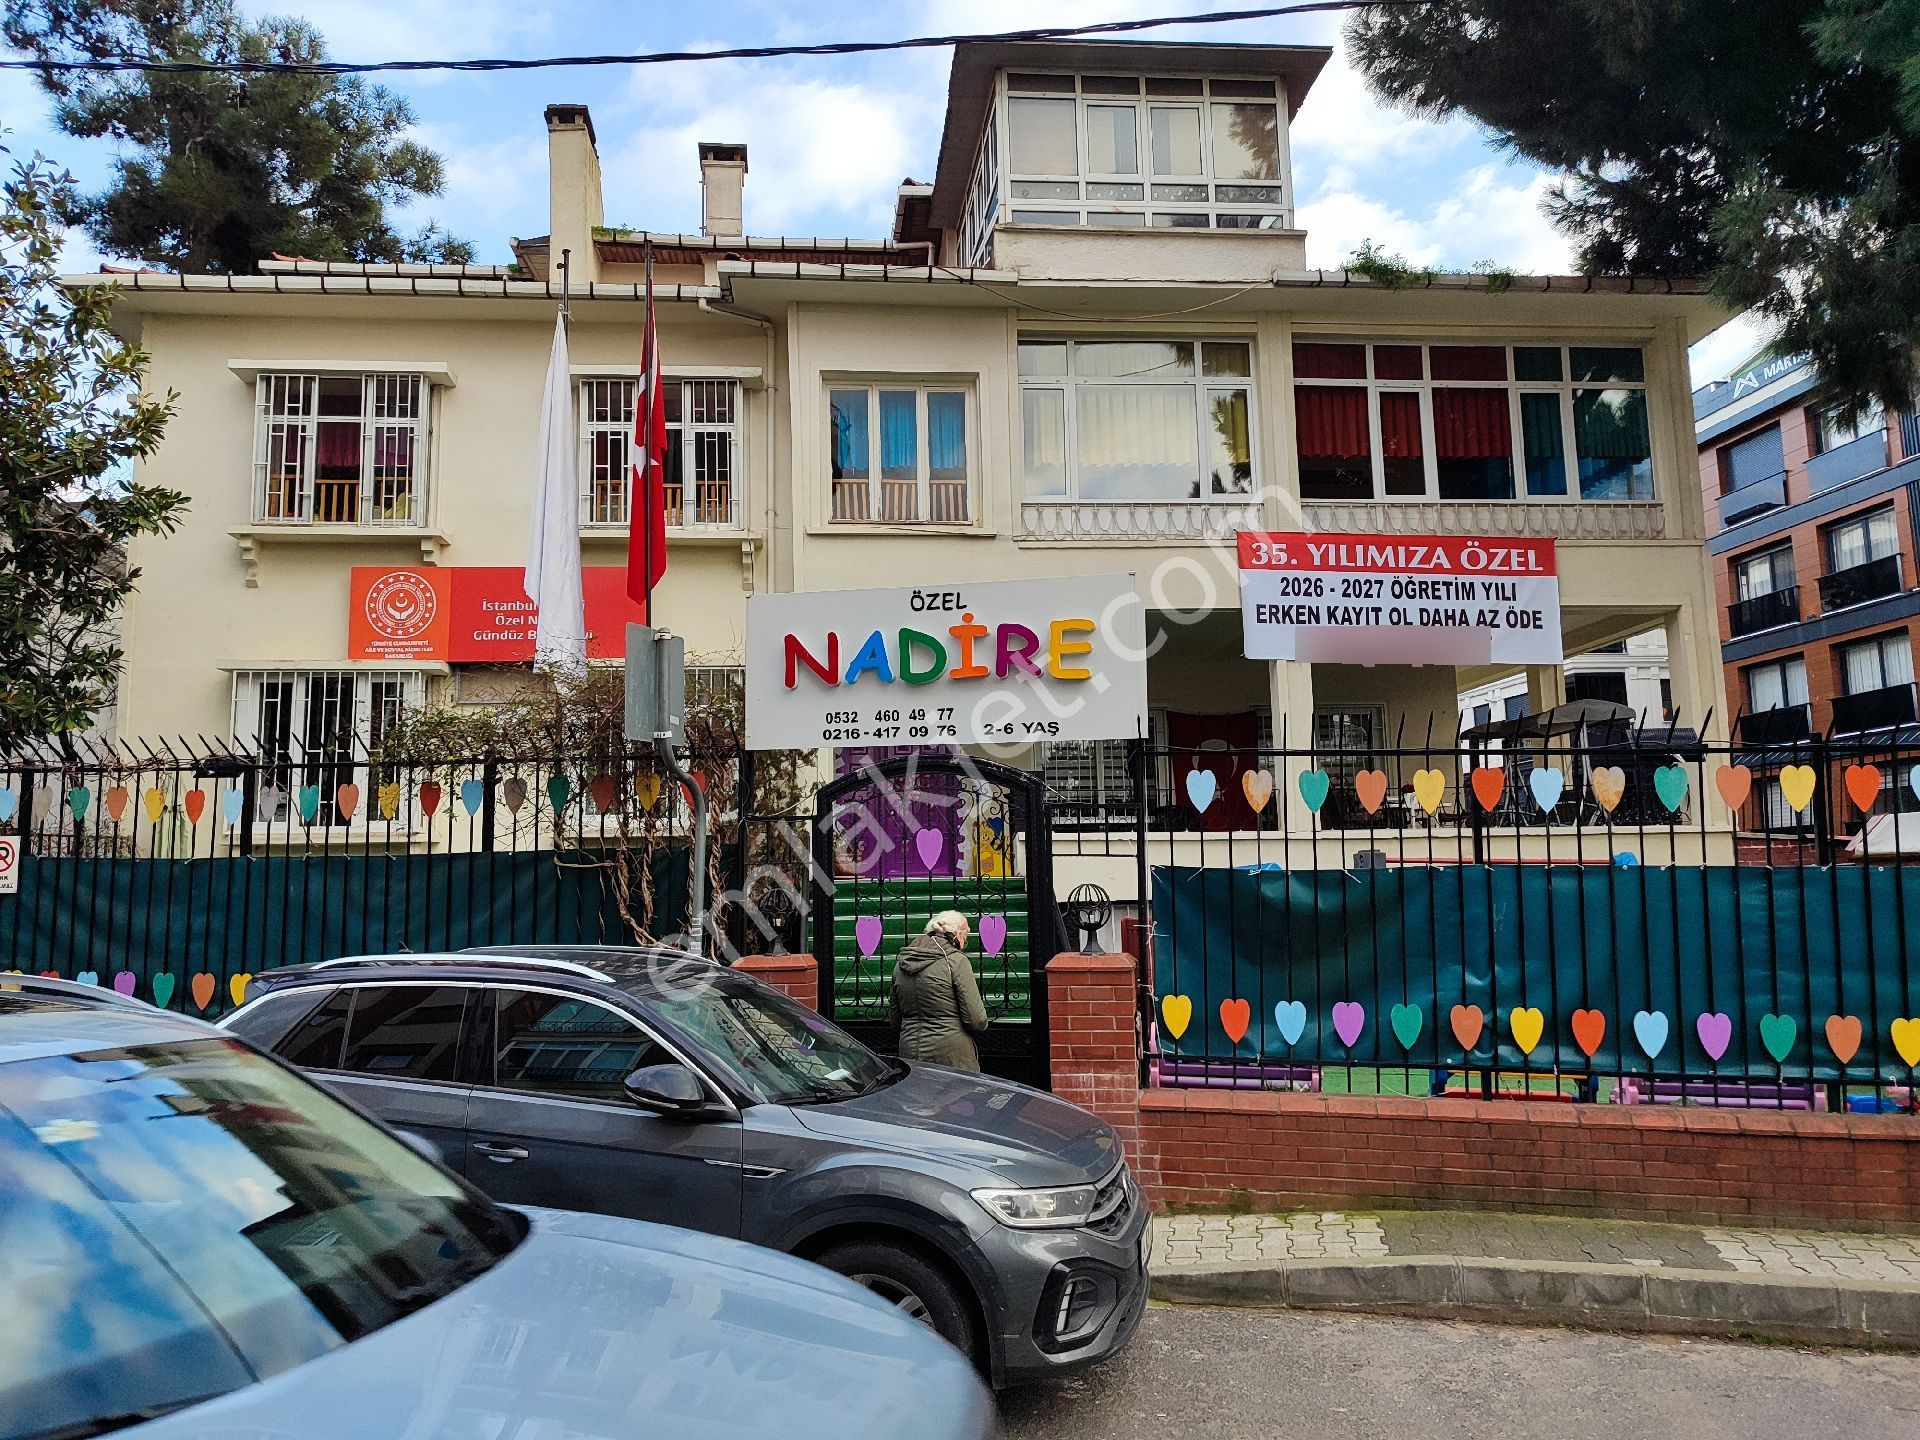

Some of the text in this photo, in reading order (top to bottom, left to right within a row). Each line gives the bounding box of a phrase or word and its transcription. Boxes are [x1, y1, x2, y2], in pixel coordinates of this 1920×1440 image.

[1251, 540, 1544, 571] 35. YILIMIZA ÖZEL
[1280, 576, 1324, 598] 2026
[1341, 578, 1384, 599] 2027
[1390, 575, 1476, 601] ÖĞRETİM
[1481, 581, 1517, 602] YILI
[910, 590, 968, 612] ÖZEL
[495, 613, 524, 626] Özel
[1256, 604, 1544, 630] ERKEN KAYIT OL DAHA AZ ÖDE
[473, 629, 525, 641] Gündüz
[783, 611, 1098, 690] NADİRE
[825, 707, 955, 724] 0532 460 49 77
[908, 725, 929, 738] 09
[936, 724, 957, 737] 76
[983, 721, 1060, 737] 2-6 YAŞ
